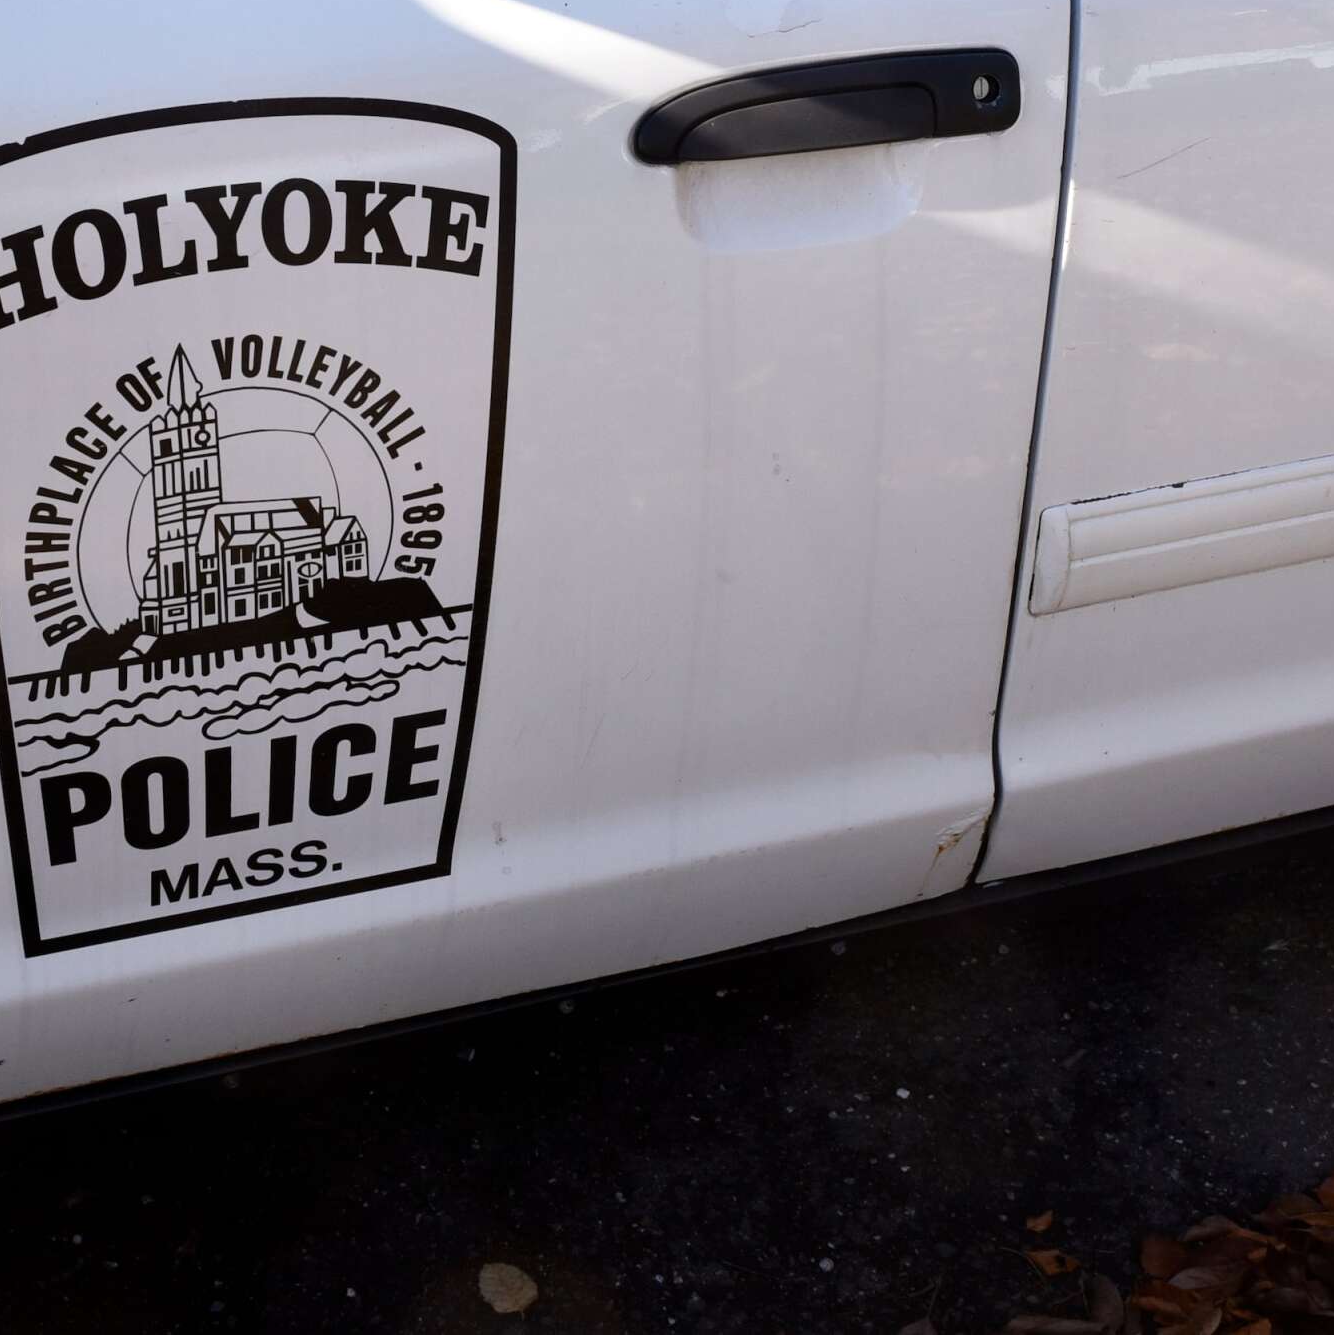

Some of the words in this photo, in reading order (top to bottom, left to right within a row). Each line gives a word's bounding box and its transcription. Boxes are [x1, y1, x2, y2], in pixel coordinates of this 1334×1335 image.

[24, 401, 128, 648] BIRTHPLACE
[115, 356, 166, 413] OF
[210, 333, 427, 460] VOLLEYBALL
[393, 481, 446, 578] 1895
[39, 708, 448, 867] POLICE
[150, 839, 343, 907] MASS.
